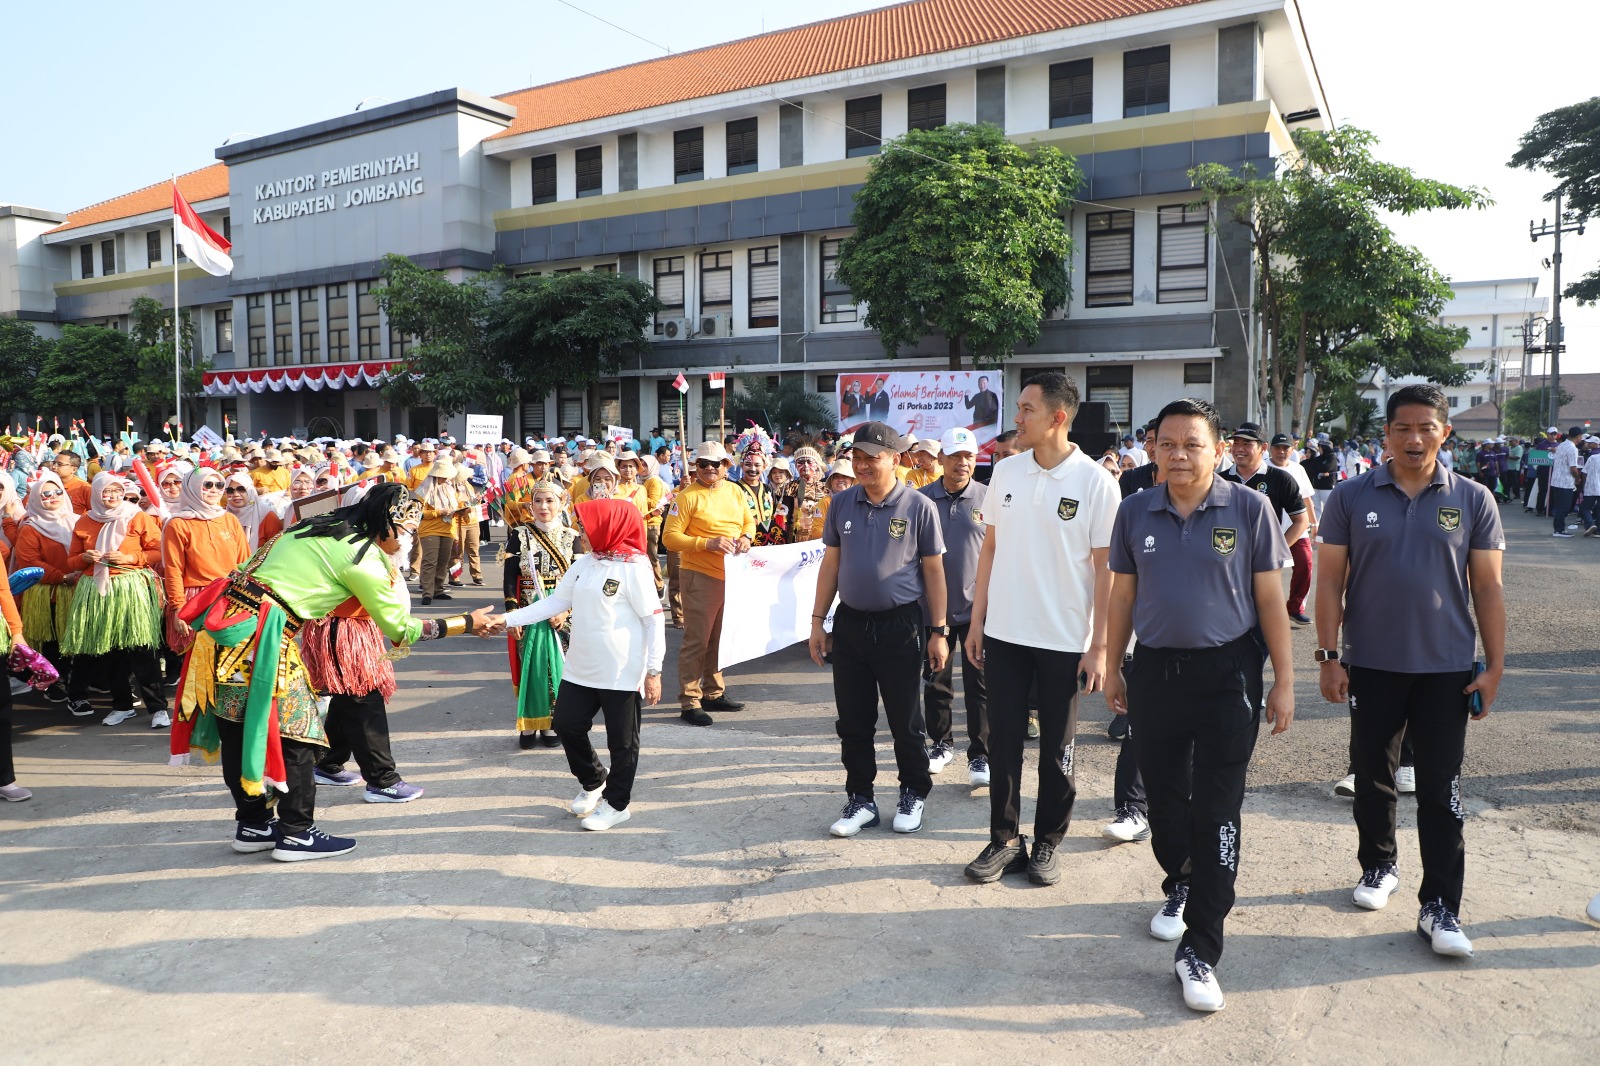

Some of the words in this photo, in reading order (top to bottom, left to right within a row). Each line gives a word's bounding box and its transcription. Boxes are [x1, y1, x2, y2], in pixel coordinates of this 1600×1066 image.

[256, 174, 316, 200] KANTOR
[321, 152, 420, 188] PEMERINTAH
[253, 194, 335, 224] KABUPATEN
[343, 177, 424, 208] JOMBANG
[890, 384, 920, 400] Selamat
[921, 384, 964, 404] Bertanding
[1220, 825, 1229, 866] UNDER
[1228, 821, 1238, 871] ARMOUR
